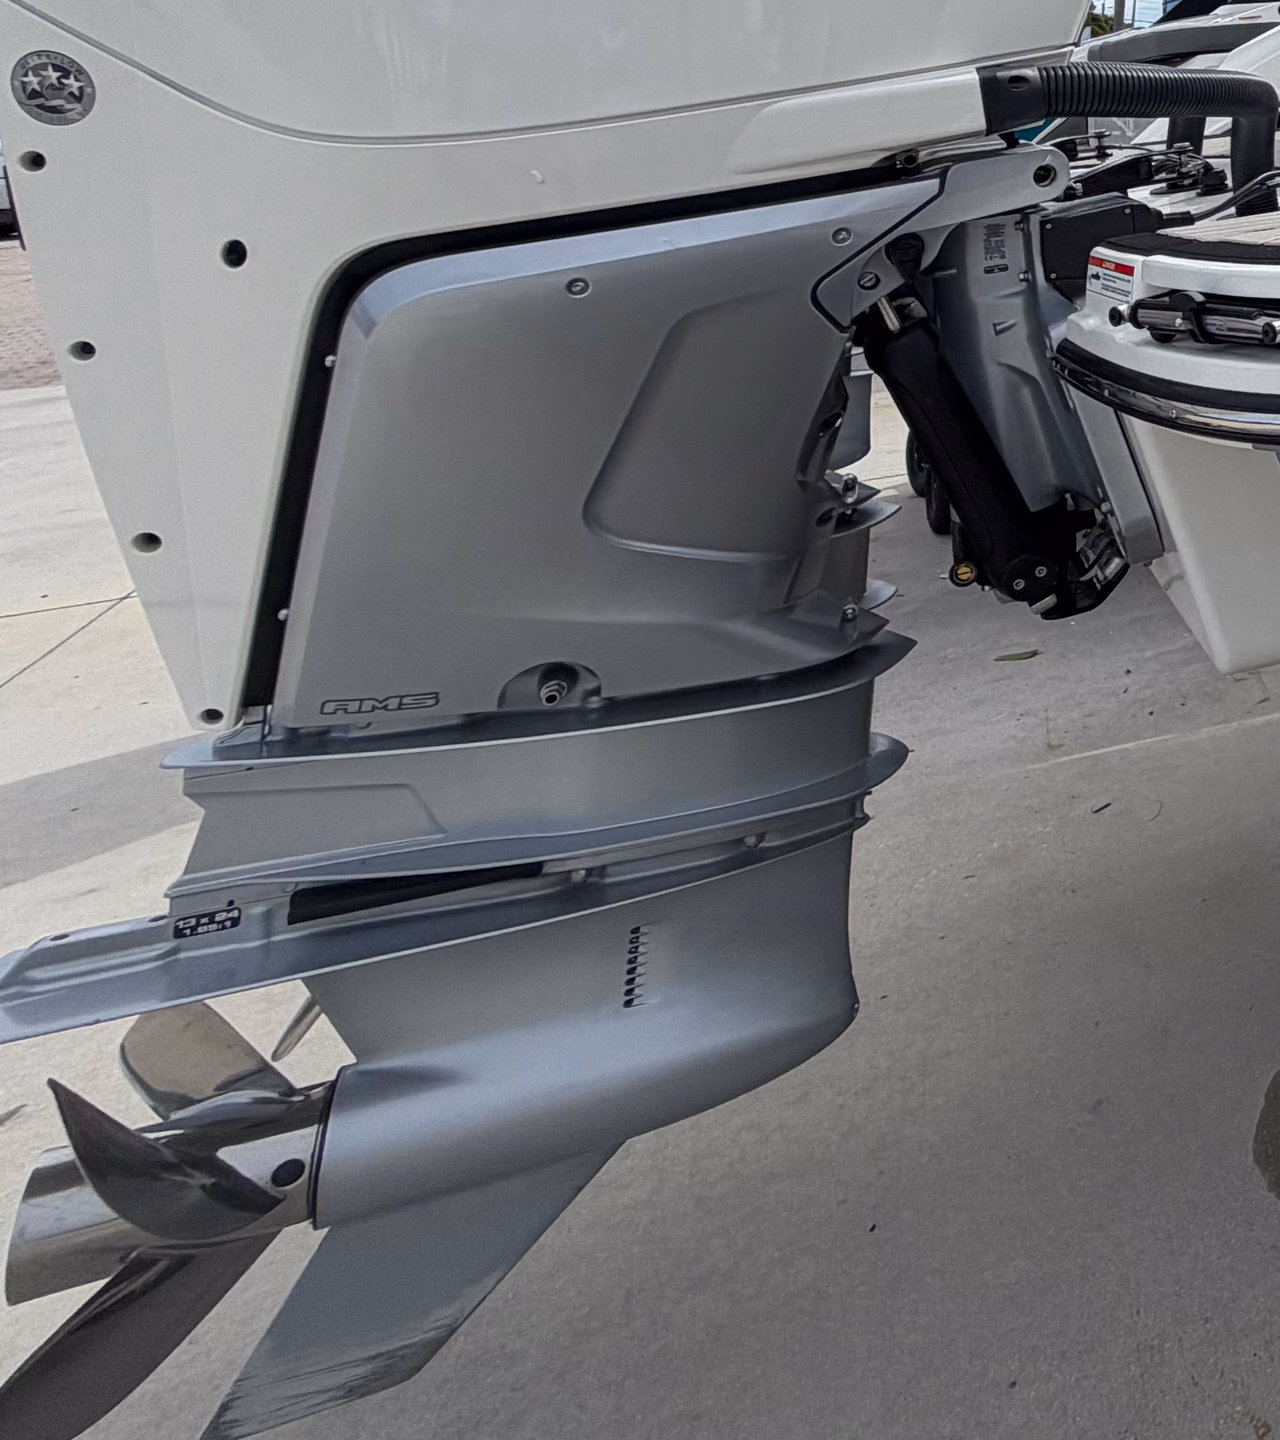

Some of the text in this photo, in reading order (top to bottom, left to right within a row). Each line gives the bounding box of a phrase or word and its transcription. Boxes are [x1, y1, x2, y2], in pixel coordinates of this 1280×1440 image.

[319, 691, 440, 715] AMS
[175, 917, 197, 929] 13
[214, 909, 240, 922] 24
